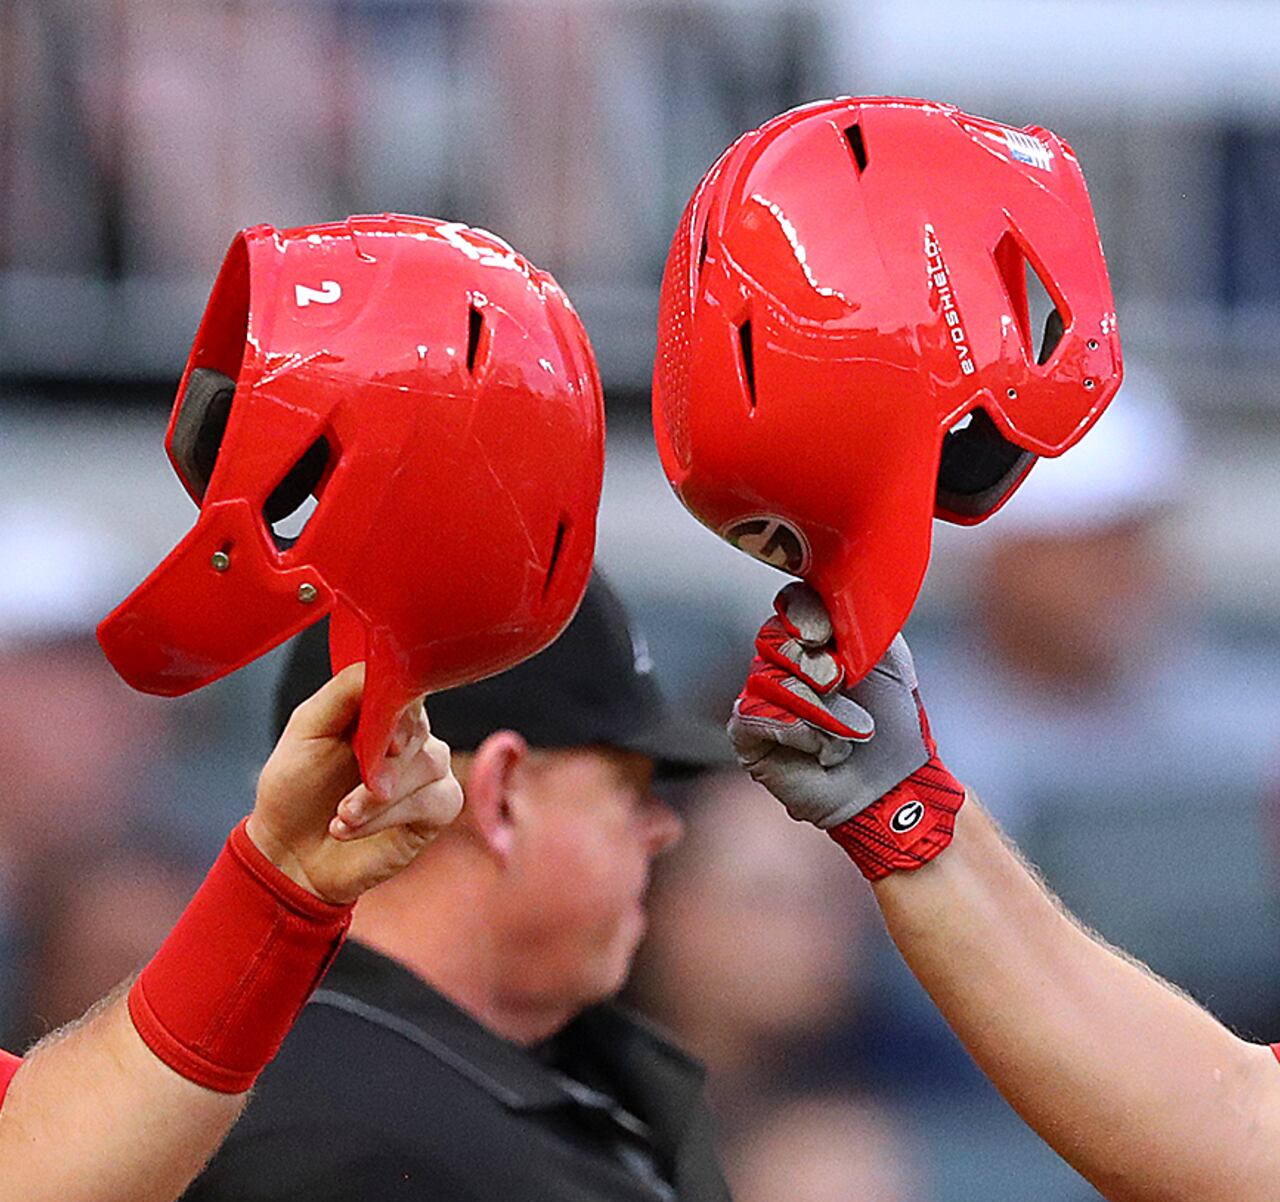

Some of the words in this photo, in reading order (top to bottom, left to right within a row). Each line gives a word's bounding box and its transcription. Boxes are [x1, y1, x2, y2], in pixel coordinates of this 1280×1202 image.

[294, 280, 342, 307] 2
[924, 238, 975, 375] EVOSHIELD
[889, 800, 924, 834] G
